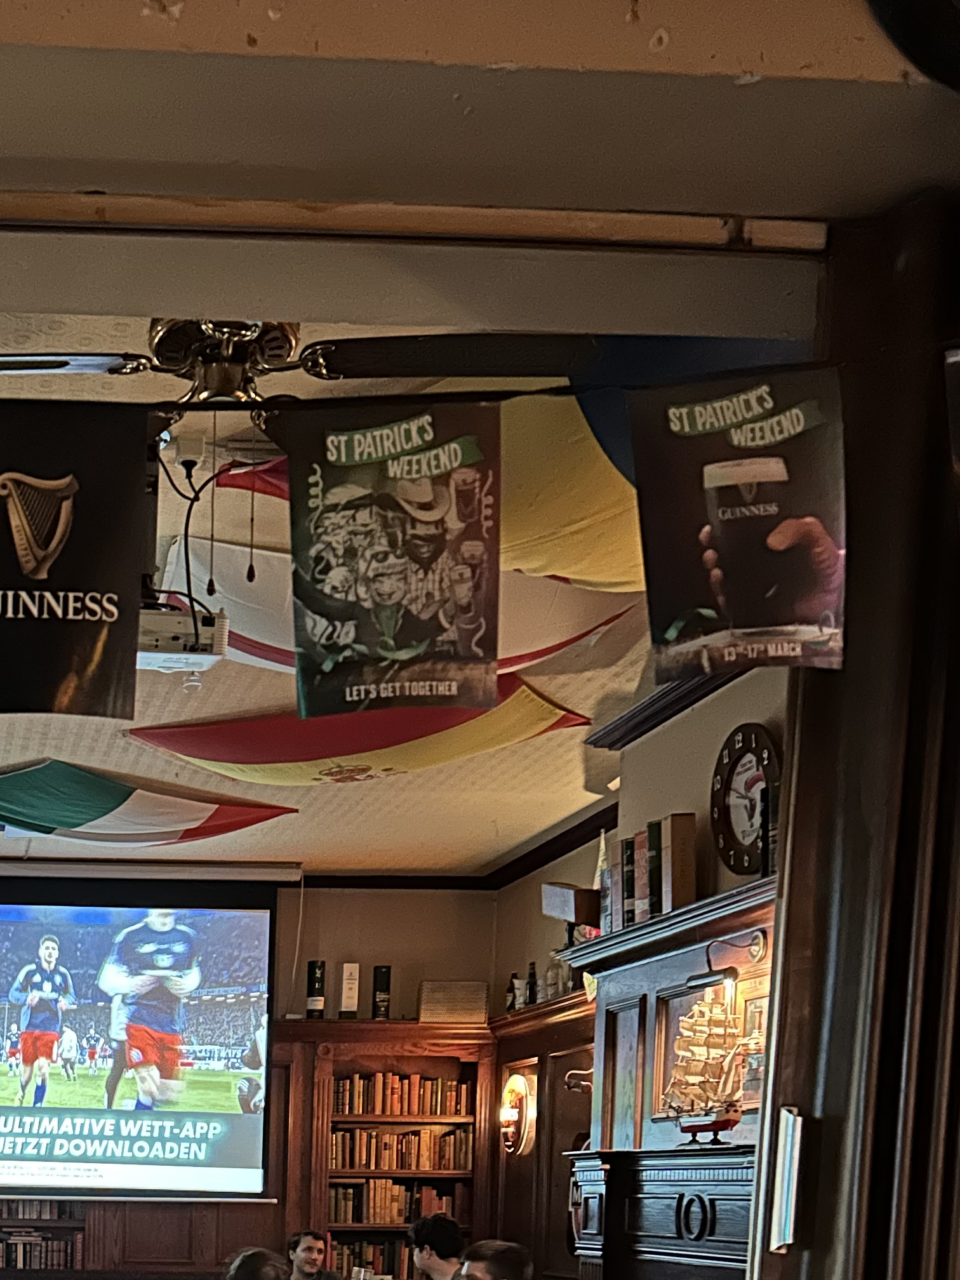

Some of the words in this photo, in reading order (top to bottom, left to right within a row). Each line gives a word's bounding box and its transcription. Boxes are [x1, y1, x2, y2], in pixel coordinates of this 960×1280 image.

[668, 407, 690, 432] ST
[694, 384, 774, 431] PATRICK'S
[731, 408, 805, 446] WEEKEND
[326, 435, 348, 462] ST
[354, 415, 434, 461] PATRICK'S
[388, 443, 462, 479] WEEKEND
[718, 502, 779, 520] GUINNESS
[767, 642, 802, 657] MARCH
[345, 684, 377, 702] LET'S
[380, 682, 402, 698] GET
[404, 681, 458, 696] TOGETHER
[119, 1119, 222, 1139] WETT-APP
[53, 1139, 207, 1160] DOWNLOADEN
